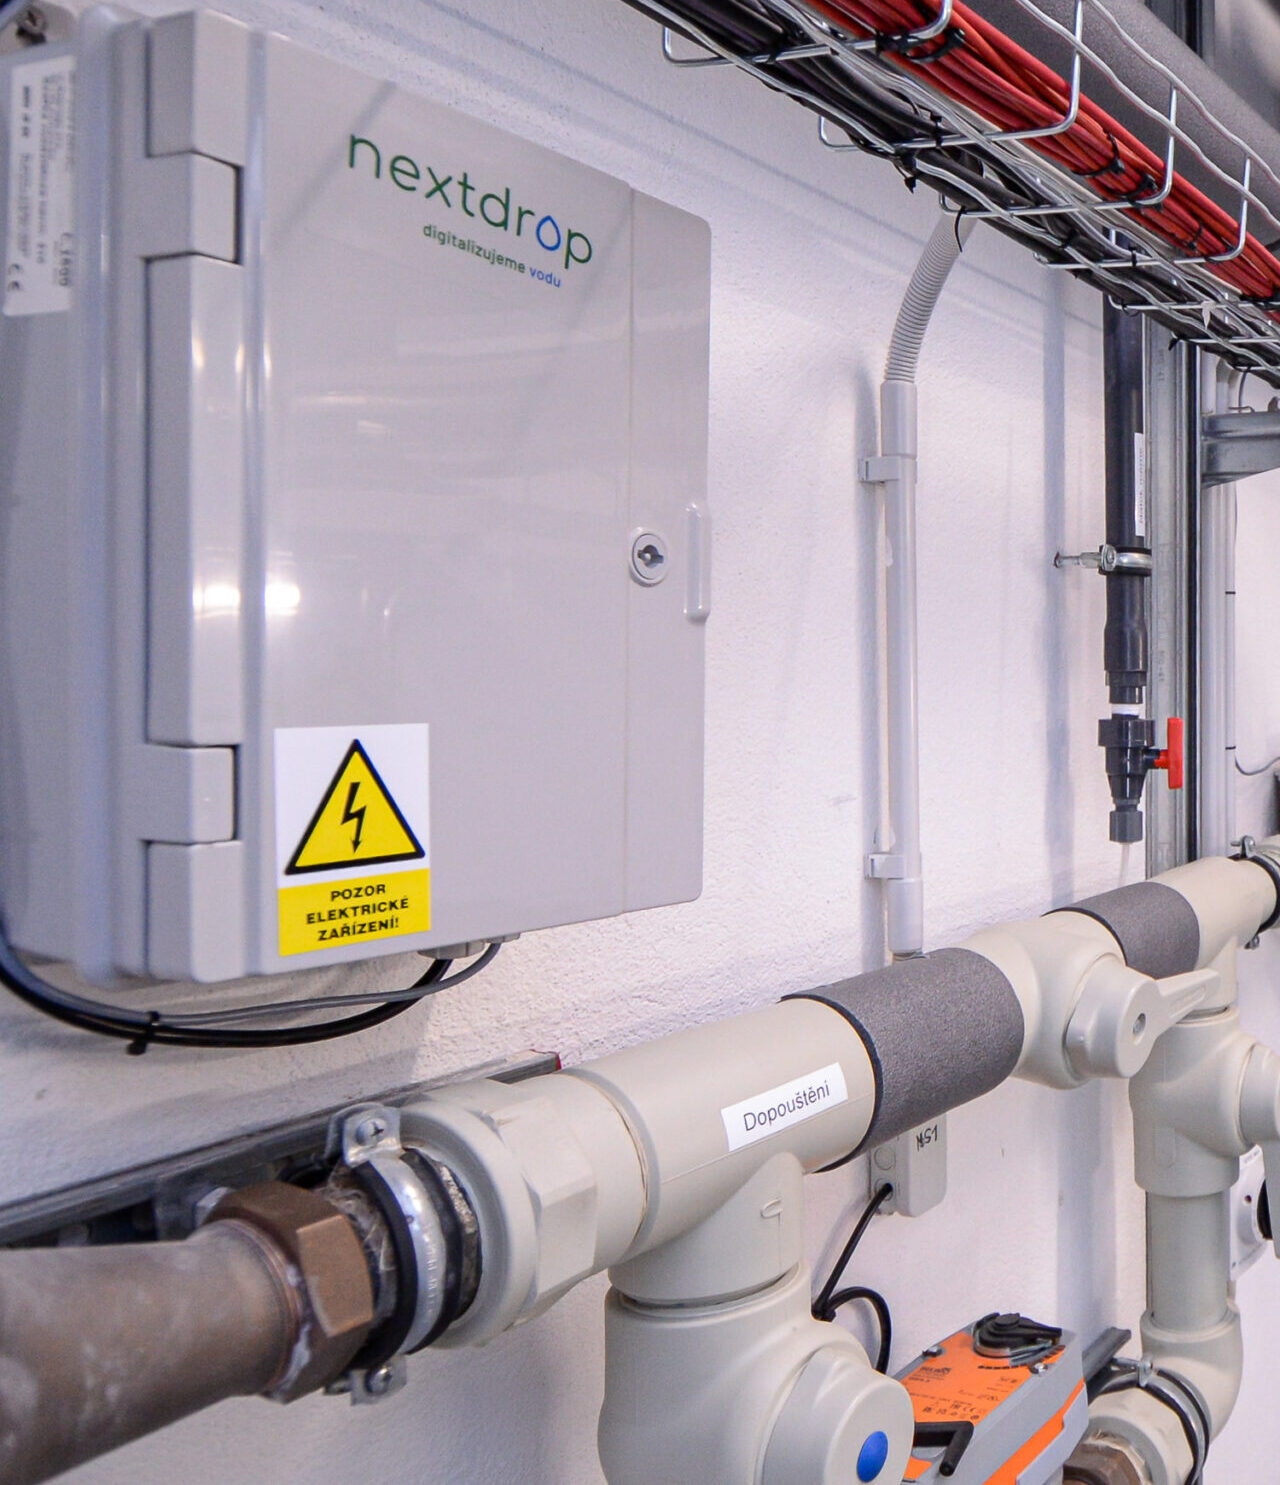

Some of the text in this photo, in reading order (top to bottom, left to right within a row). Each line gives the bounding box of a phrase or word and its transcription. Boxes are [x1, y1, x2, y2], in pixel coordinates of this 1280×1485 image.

[349, 134, 592, 269] nextdrop
[423, 224, 561, 288] digitalizujeme vodu
[306, 895, 409, 924] ELEKTRICKÉ
[331, 884, 386, 901] POZOR
[318, 916, 399, 941] ZAŘÍZENÍ!
[743, 1080, 830, 1131] Dopouštění
